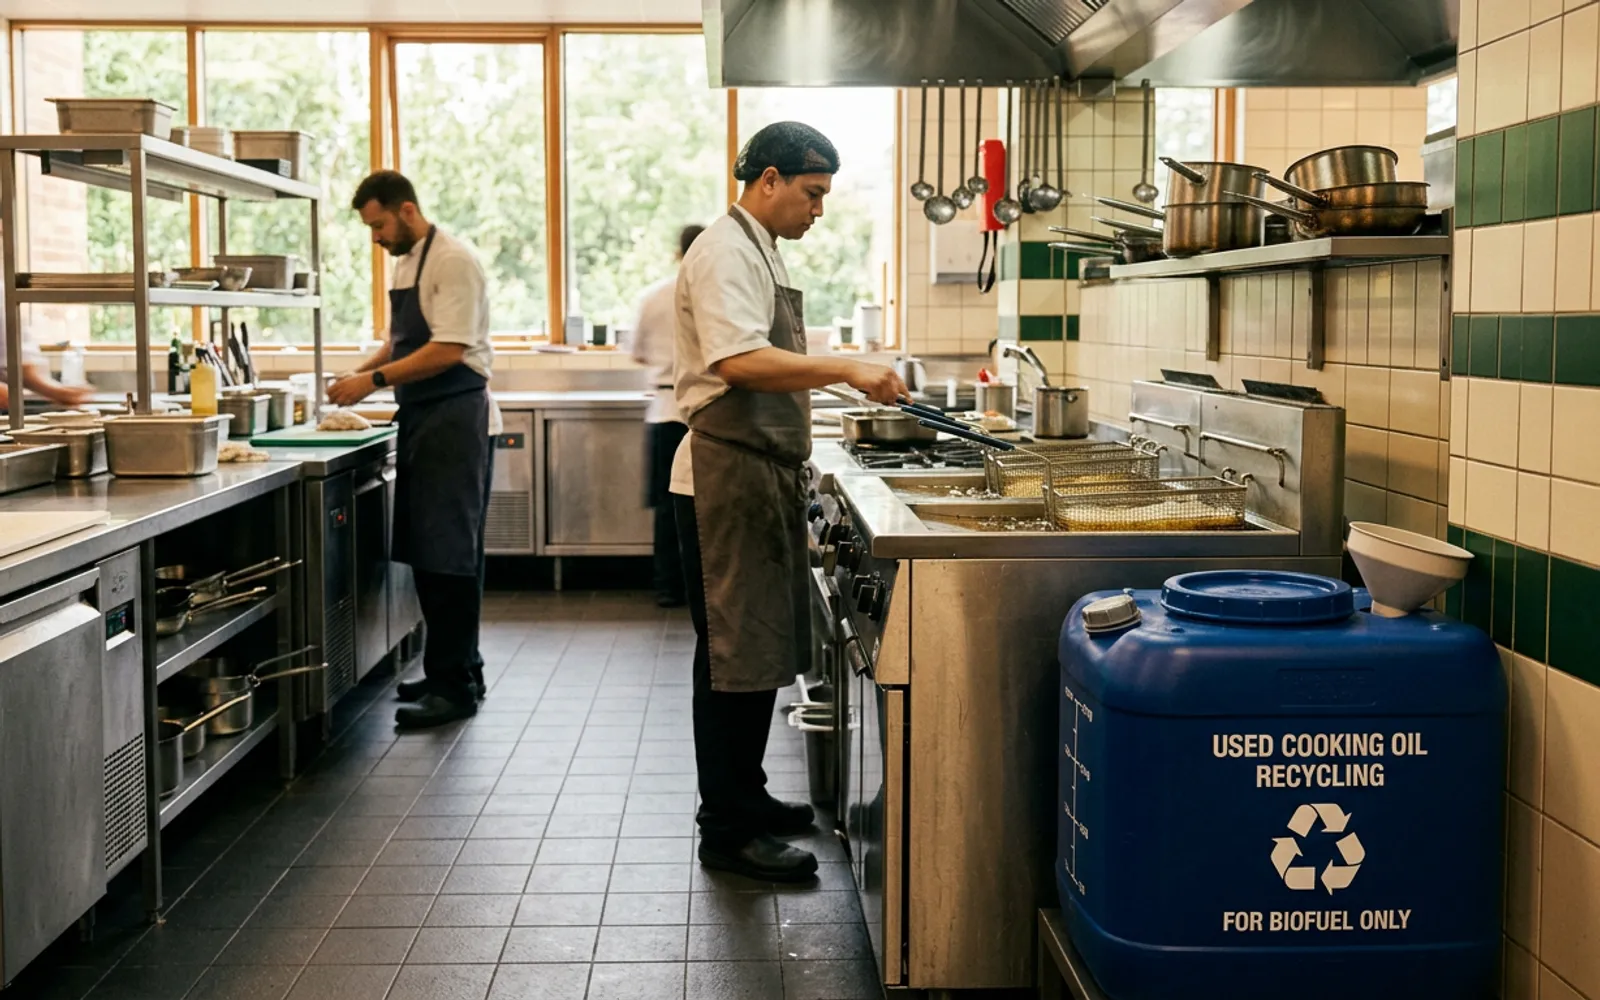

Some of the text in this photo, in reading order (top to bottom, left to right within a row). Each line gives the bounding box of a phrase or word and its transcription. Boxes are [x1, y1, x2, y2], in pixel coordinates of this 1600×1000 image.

[1213, 732, 1428, 758] USED COOKING OIL
[1256, 763, 1385, 788] RECYCLING
[1223, 909, 1412, 932] FOR BIOFUEL ONLY
